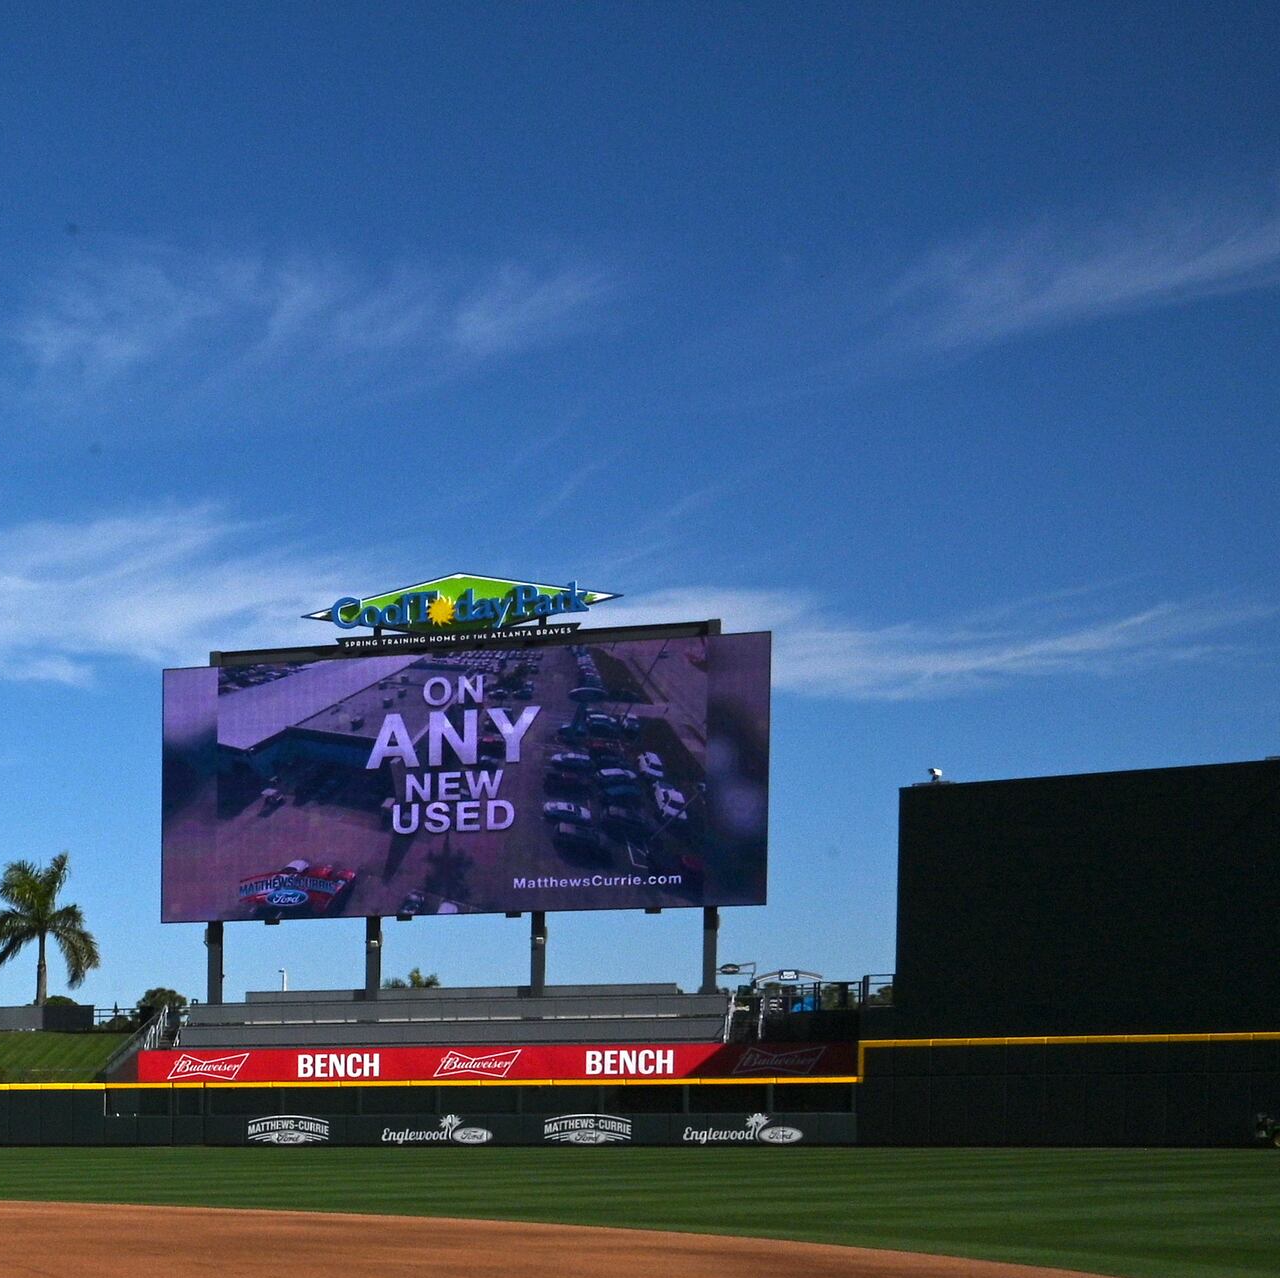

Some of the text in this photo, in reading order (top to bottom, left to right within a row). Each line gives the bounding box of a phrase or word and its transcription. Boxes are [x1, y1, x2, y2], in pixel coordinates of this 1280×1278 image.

[345, 639, 378, 648] SPRING
[382, 635, 426, 646] TRAINING
[429, 634, 457, 643] HOME
[491, 629, 532, 639] ATLANTA
[536, 627, 572, 636] BRAVES
[423, 674, 484, 706] ON
[365, 705, 541, 769] ANY
[405, 769, 503, 802] NEW
[392, 800, 515, 834] USED
[513, 873, 683, 889] MatthewsCurrie.com
[175, 1058, 240, 1074] Budweiser
[297, 1053, 380, 1078] BENCH
[441, 1056, 512, 1071] Budweiser
[585, 1049, 674, 1075] BENCH
[247, 1119, 330, 1136] MATTHEWS-CURRIE
[381, 1127, 448, 1145] Englewood
[543, 1118, 632, 1135] MATTHEWS-CURRIE
[683, 1126, 755, 1144] Englewood
